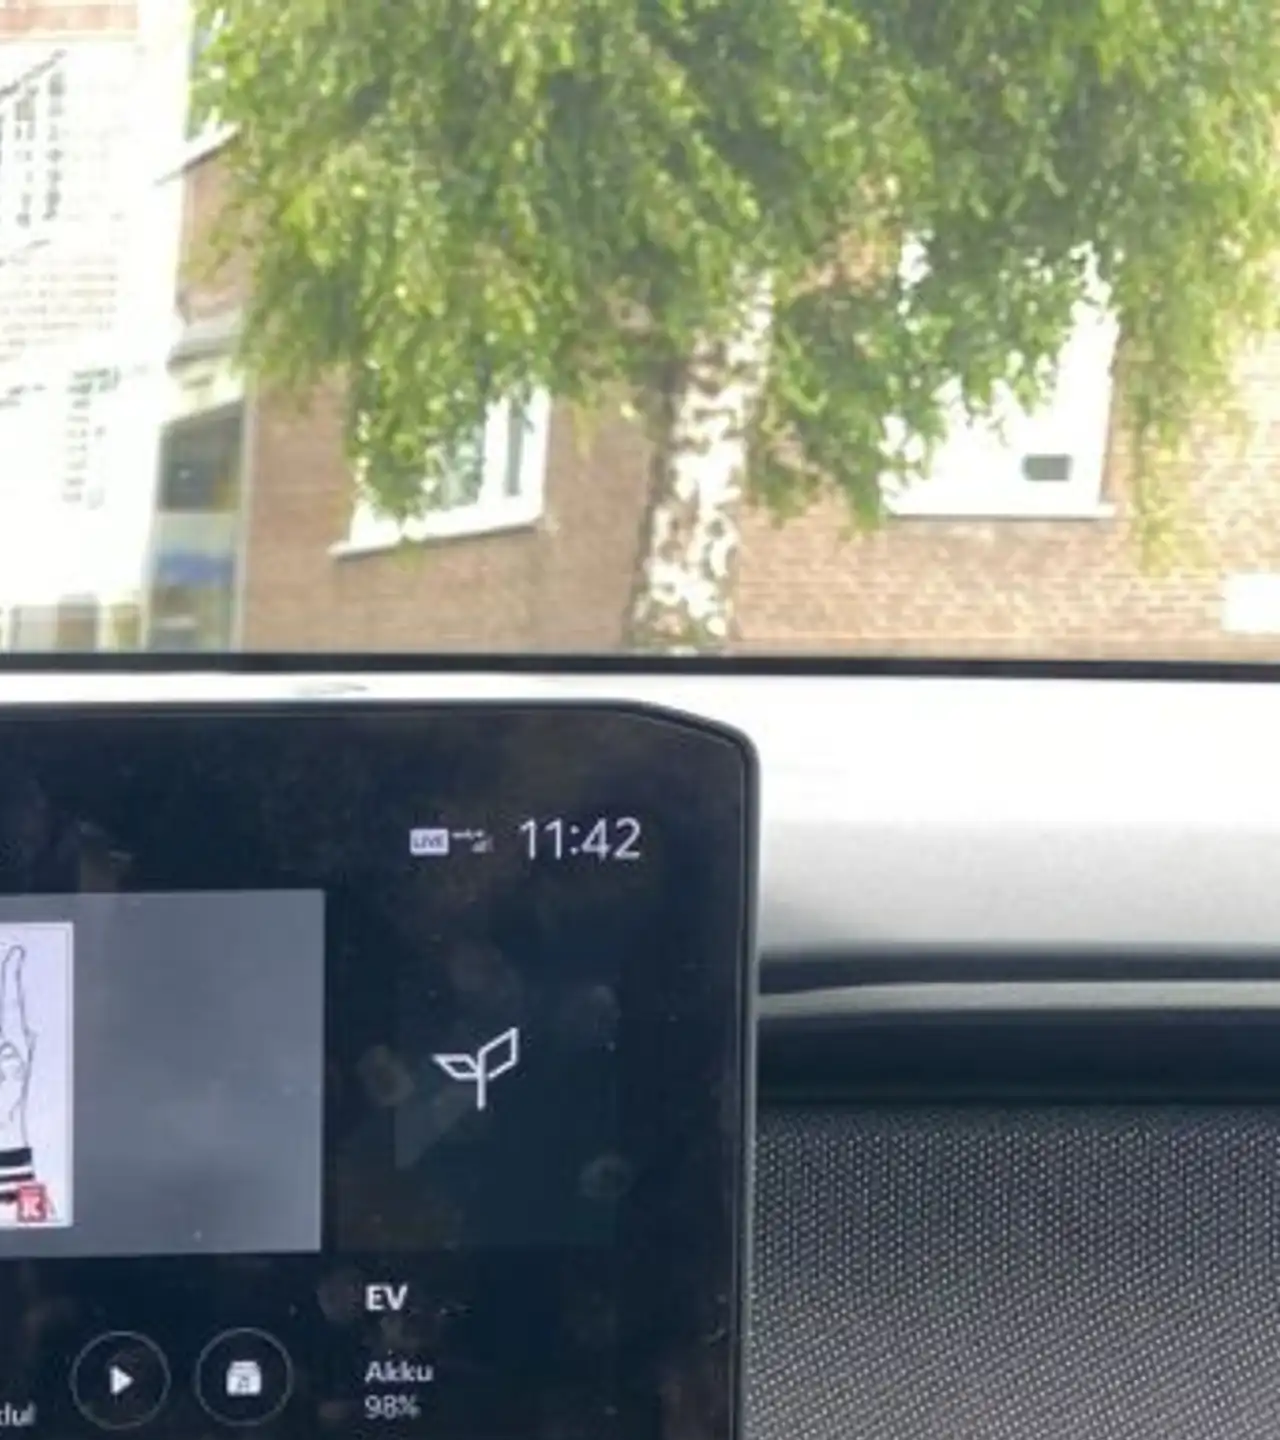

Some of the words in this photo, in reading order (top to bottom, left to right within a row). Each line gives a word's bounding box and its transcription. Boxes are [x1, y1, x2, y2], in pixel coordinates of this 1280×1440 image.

[520, 817, 642, 861] 11:42
[365, 1284, 408, 1312] EV
[365, 1360, 434, 1384] Akku
[365, 1395, 420, 1420] 98%
